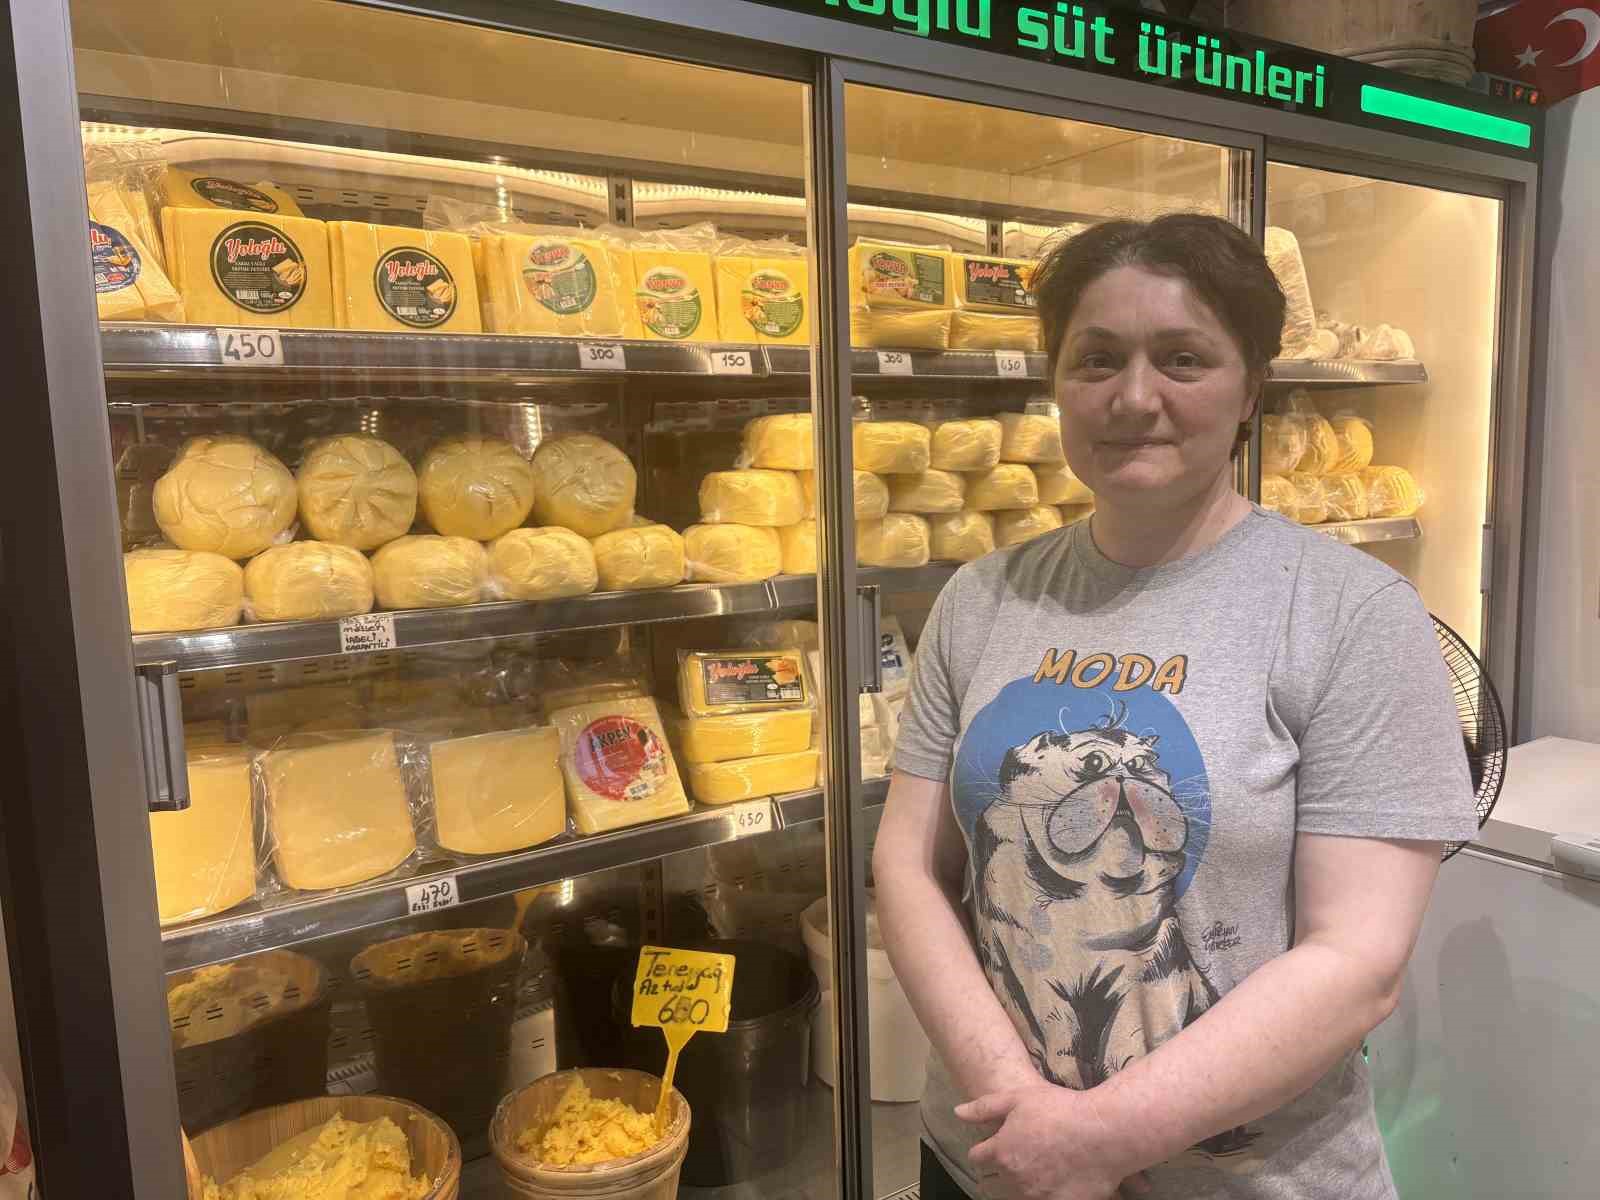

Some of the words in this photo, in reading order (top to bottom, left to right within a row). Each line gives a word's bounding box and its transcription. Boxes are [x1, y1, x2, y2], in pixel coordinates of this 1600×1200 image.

[1017, 2, 1116, 65] süt
[1138, 22, 1325, 108] ürünleri
[224, 334, 275, 360] 450
[721, 354, 746, 367] 150
[1032, 647, 1188, 695] MODA
[421, 881, 450, 904] 470
